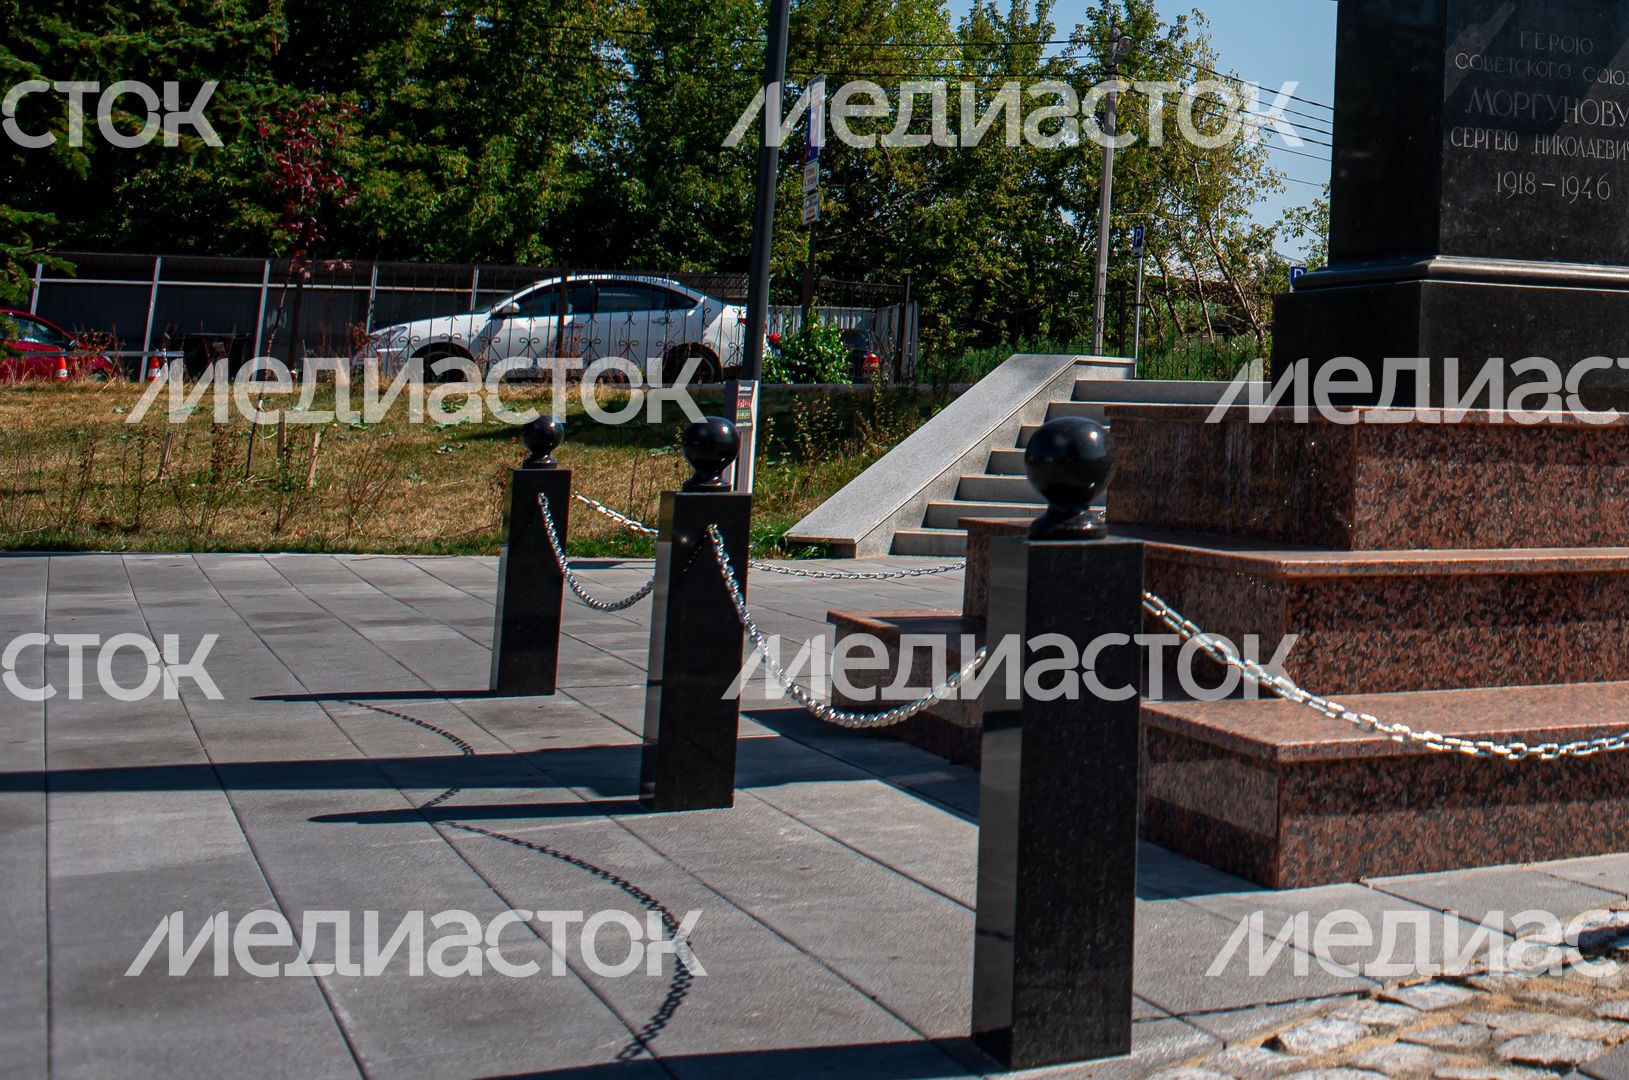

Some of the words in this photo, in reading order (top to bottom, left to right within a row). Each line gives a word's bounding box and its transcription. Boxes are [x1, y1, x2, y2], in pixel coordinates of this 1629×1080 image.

[1519, 30, 1594, 56] ГЕРОЮ
[1455, 52, 1571, 80] СОВЕТСКОГО
[1450, 126, 1519, 152] СЕРГЕЮ
